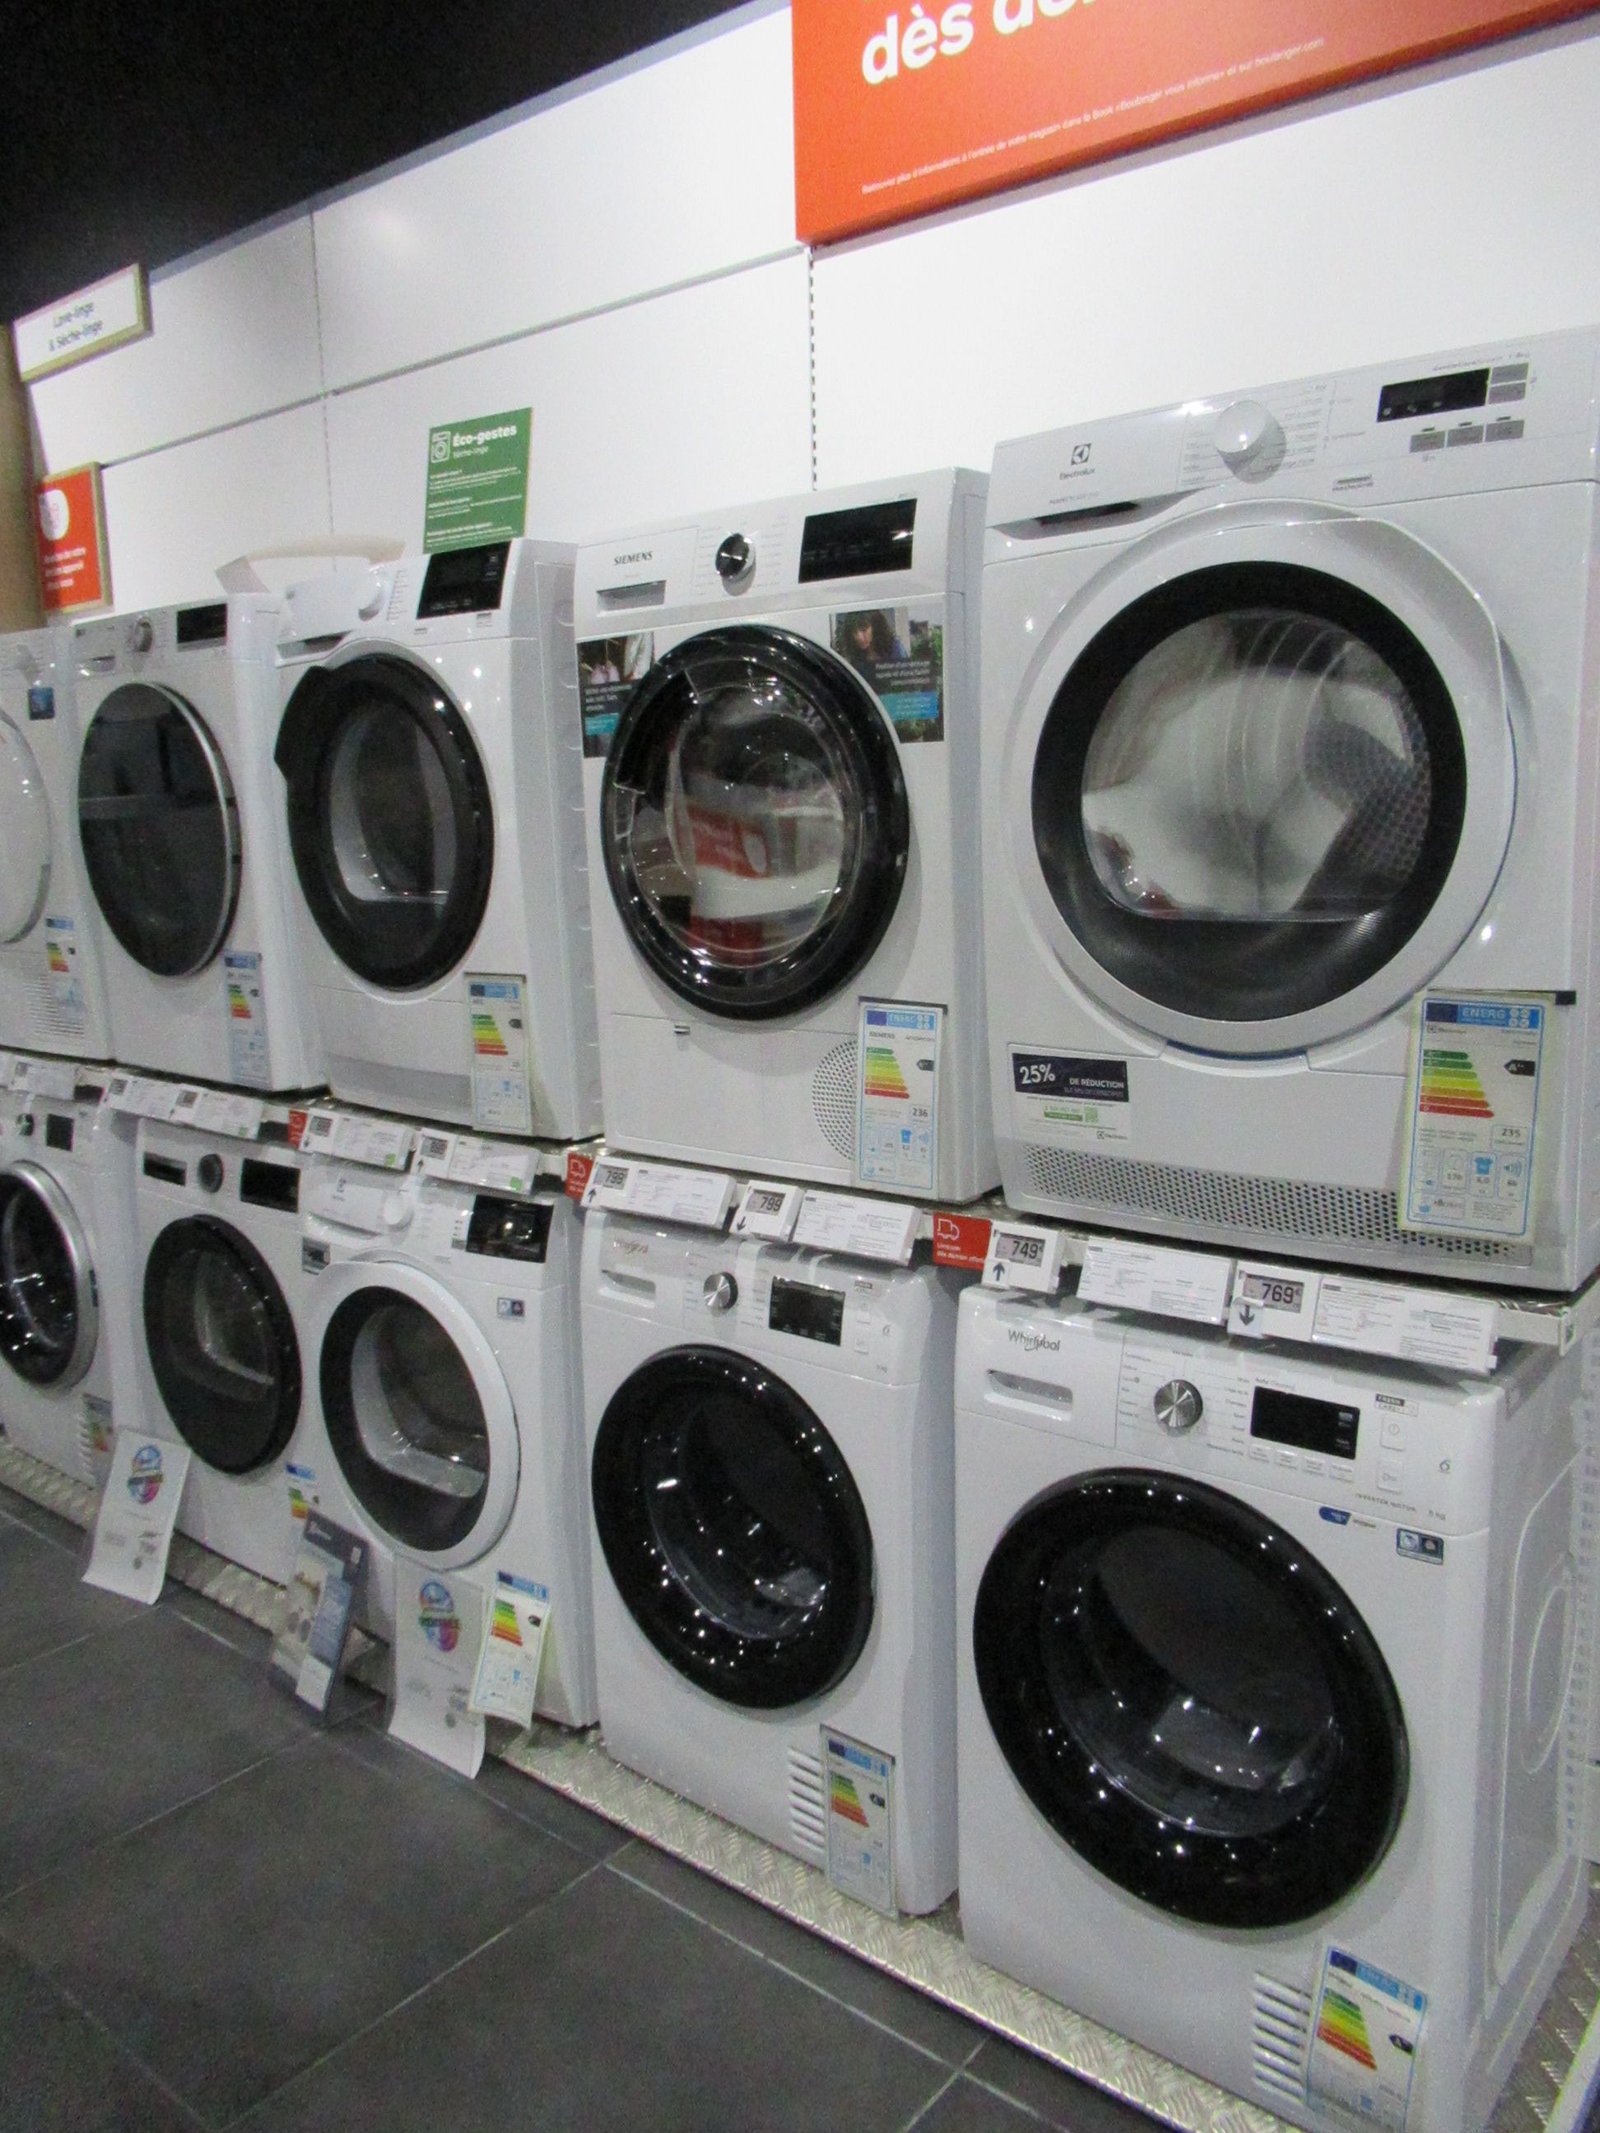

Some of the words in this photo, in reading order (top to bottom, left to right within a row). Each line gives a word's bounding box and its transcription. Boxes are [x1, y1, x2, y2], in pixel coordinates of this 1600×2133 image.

[862, 3, 974, 84] dès
[614, 551, 654, 566] SIEMENS
[1019, 1063, 1056, 1084] 25%
[1008, 1328, 1061, 1352] Whirlpool
